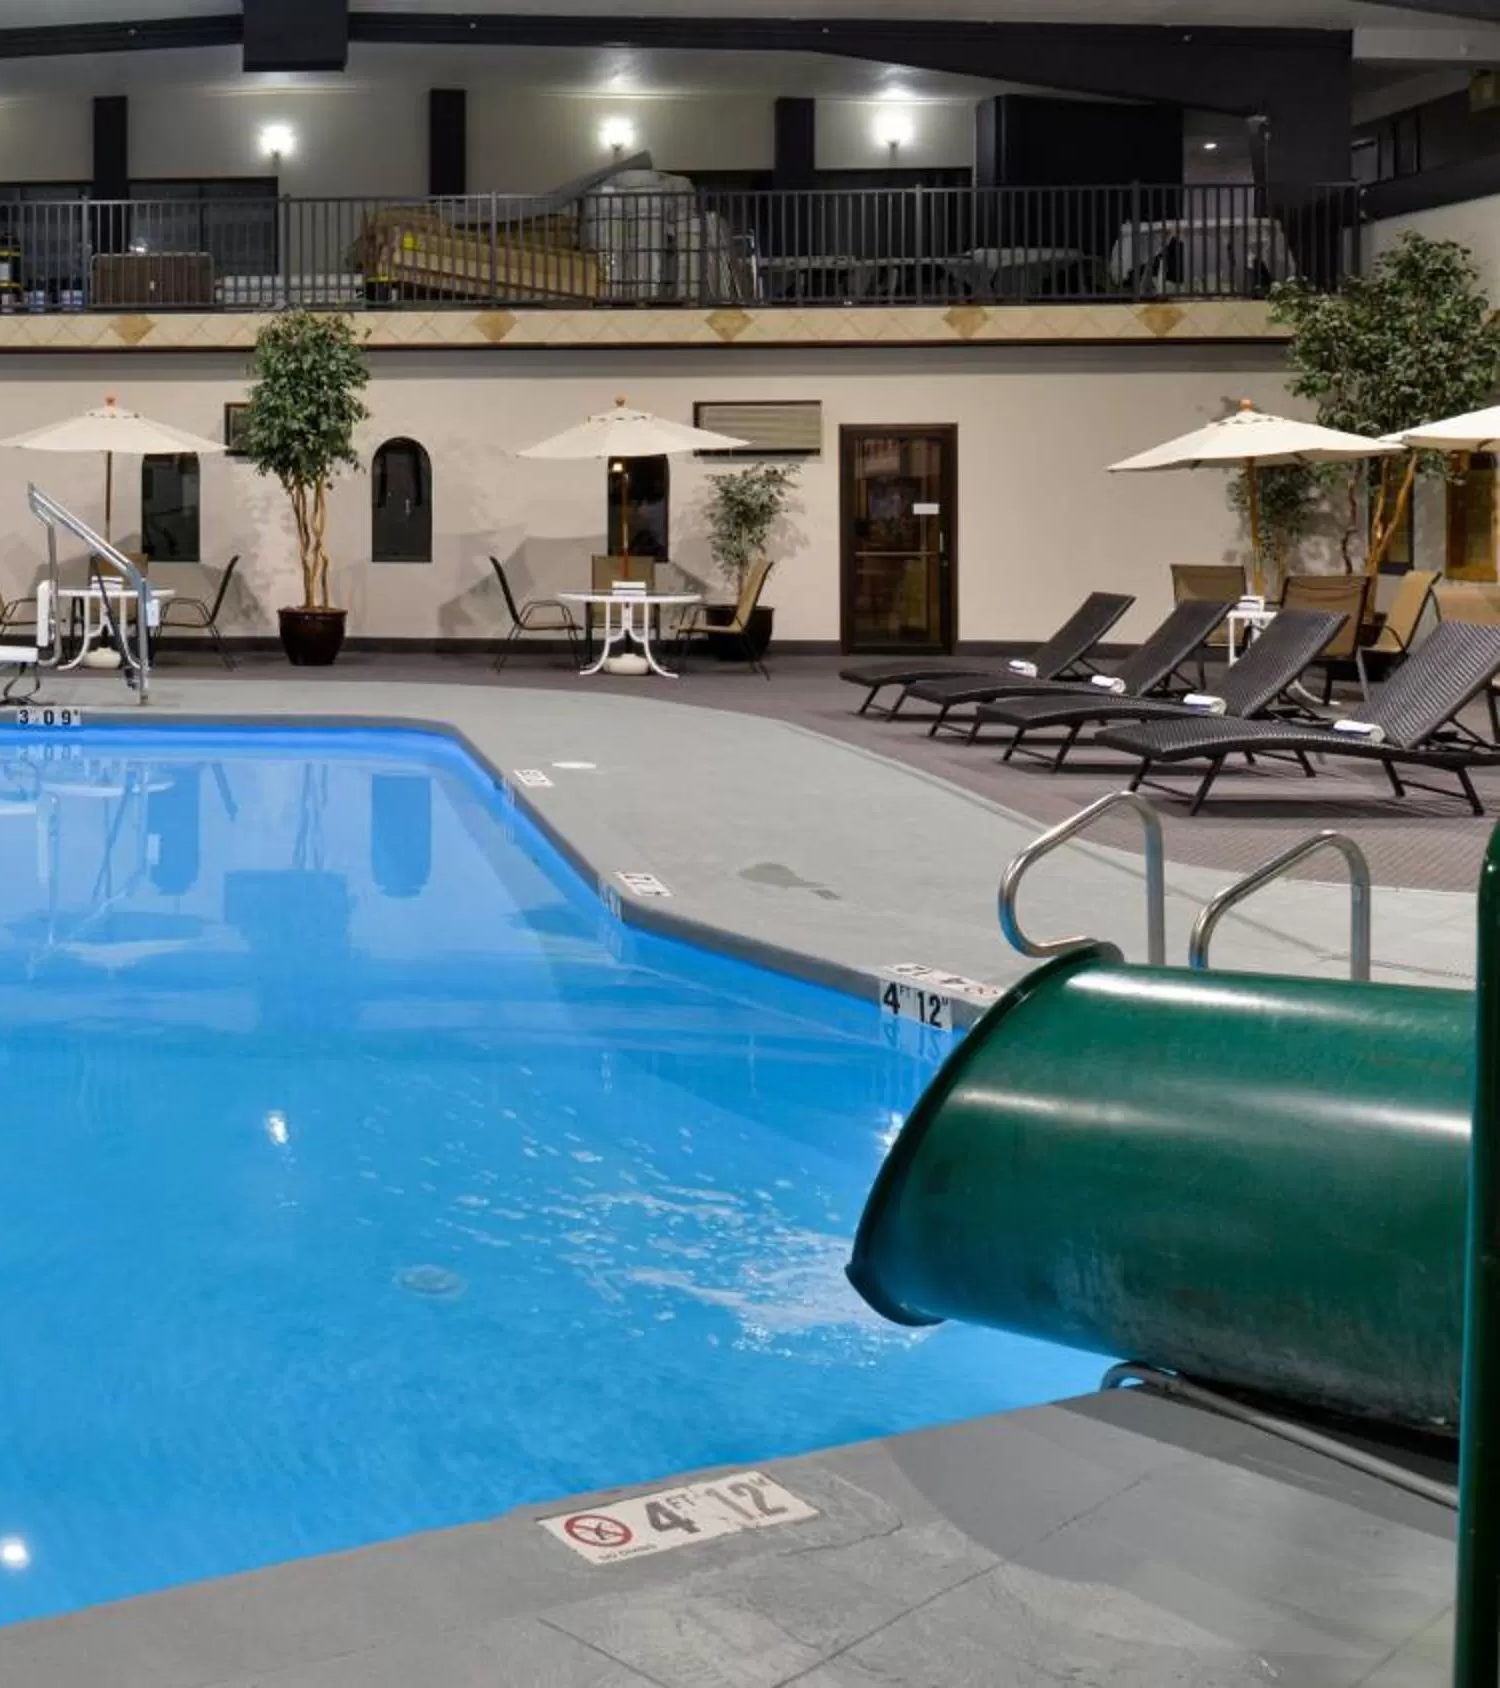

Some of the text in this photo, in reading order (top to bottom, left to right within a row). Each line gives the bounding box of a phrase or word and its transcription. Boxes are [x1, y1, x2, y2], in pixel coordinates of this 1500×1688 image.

[19, 709, 29, 725] 3
[883, 981, 901, 1015] 4
[918, 990, 942, 1029] 12
[645, 1501, 702, 1534] 4
[704, 1482, 789, 1520] 12
